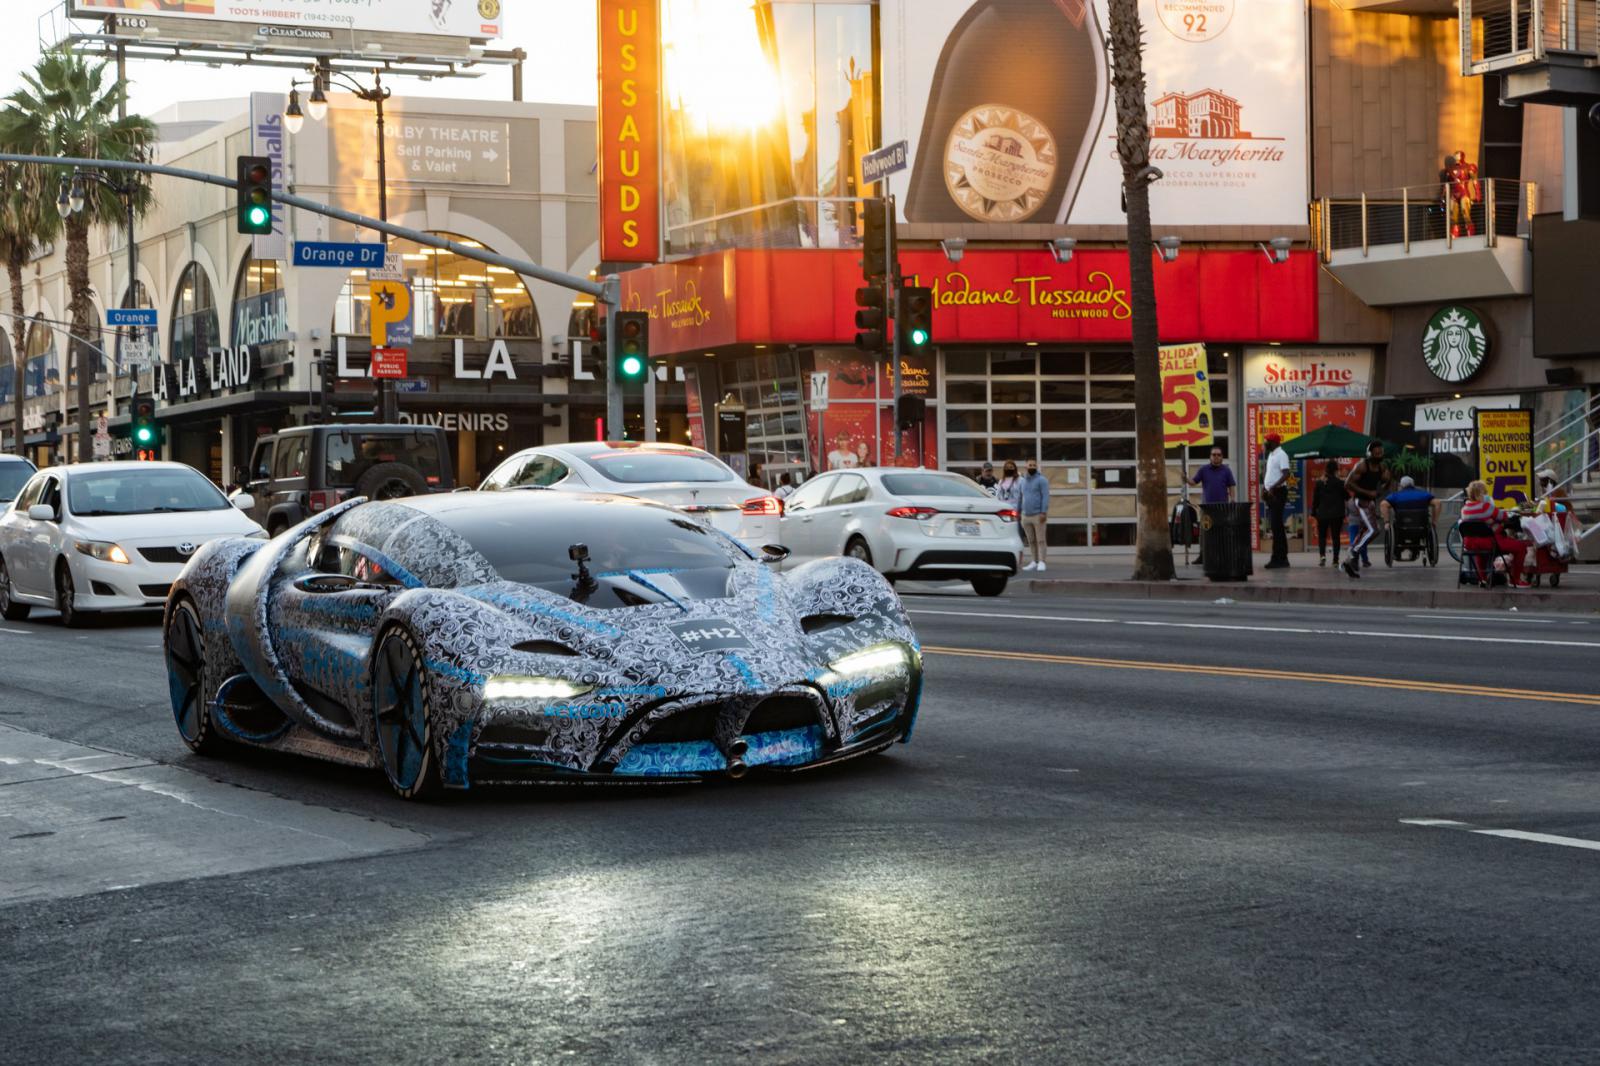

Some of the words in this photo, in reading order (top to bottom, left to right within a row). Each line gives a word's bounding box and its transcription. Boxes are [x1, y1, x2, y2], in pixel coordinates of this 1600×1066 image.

[229, 7, 260, 17] TOOTS
[262, 10, 302, 19] HIBBERT
[1163, 4, 1225, 13] RECOMMENDED
[116, 17, 148, 28] 1160
[1183, 14, 1207, 33] 92
[374, 125, 424, 140] OLBY
[430, 127, 500, 143] THEATRE
[617, 8, 641, 248] USSAUDS
[397, 145, 421, 157] Self
[425, 146, 472, 161] Parking
[1168, 141, 1285, 168] Margherita
[411, 160, 421, 171] &
[426, 160, 457, 173] Valet
[863, 150, 896, 177] Hollywood
[301, 246, 355, 265] Orange
[361, 248, 378, 262] Dr
[1013, 271, 1132, 320] Tussauds
[114, 312, 151, 325] Orange
[1052, 309, 1109, 318] HOLLYWOOD
[455, 338, 517, 380] LA
[1158, 347, 1199, 361] OLIDAY
[151, 362, 168, 401] LA
[179, 356, 197, 397] LA
[210, 344, 251, 391] LAND
[1158, 358, 1197, 372] SALE!
[1269, 384, 1305, 393] TOURS
[1163, 373, 1200, 426] 5
[1259, 412, 1300, 425] FREE
[1423, 407, 1464, 422] We're
[399, 413, 509, 432] OUVENIRS
[1482, 432, 1531, 442] HOLLYWOOD
[1482, 443, 1530, 454] SOUVENIRS
[1486, 460, 1527, 473] ONLY
[681, 628, 742, 643] #H2
